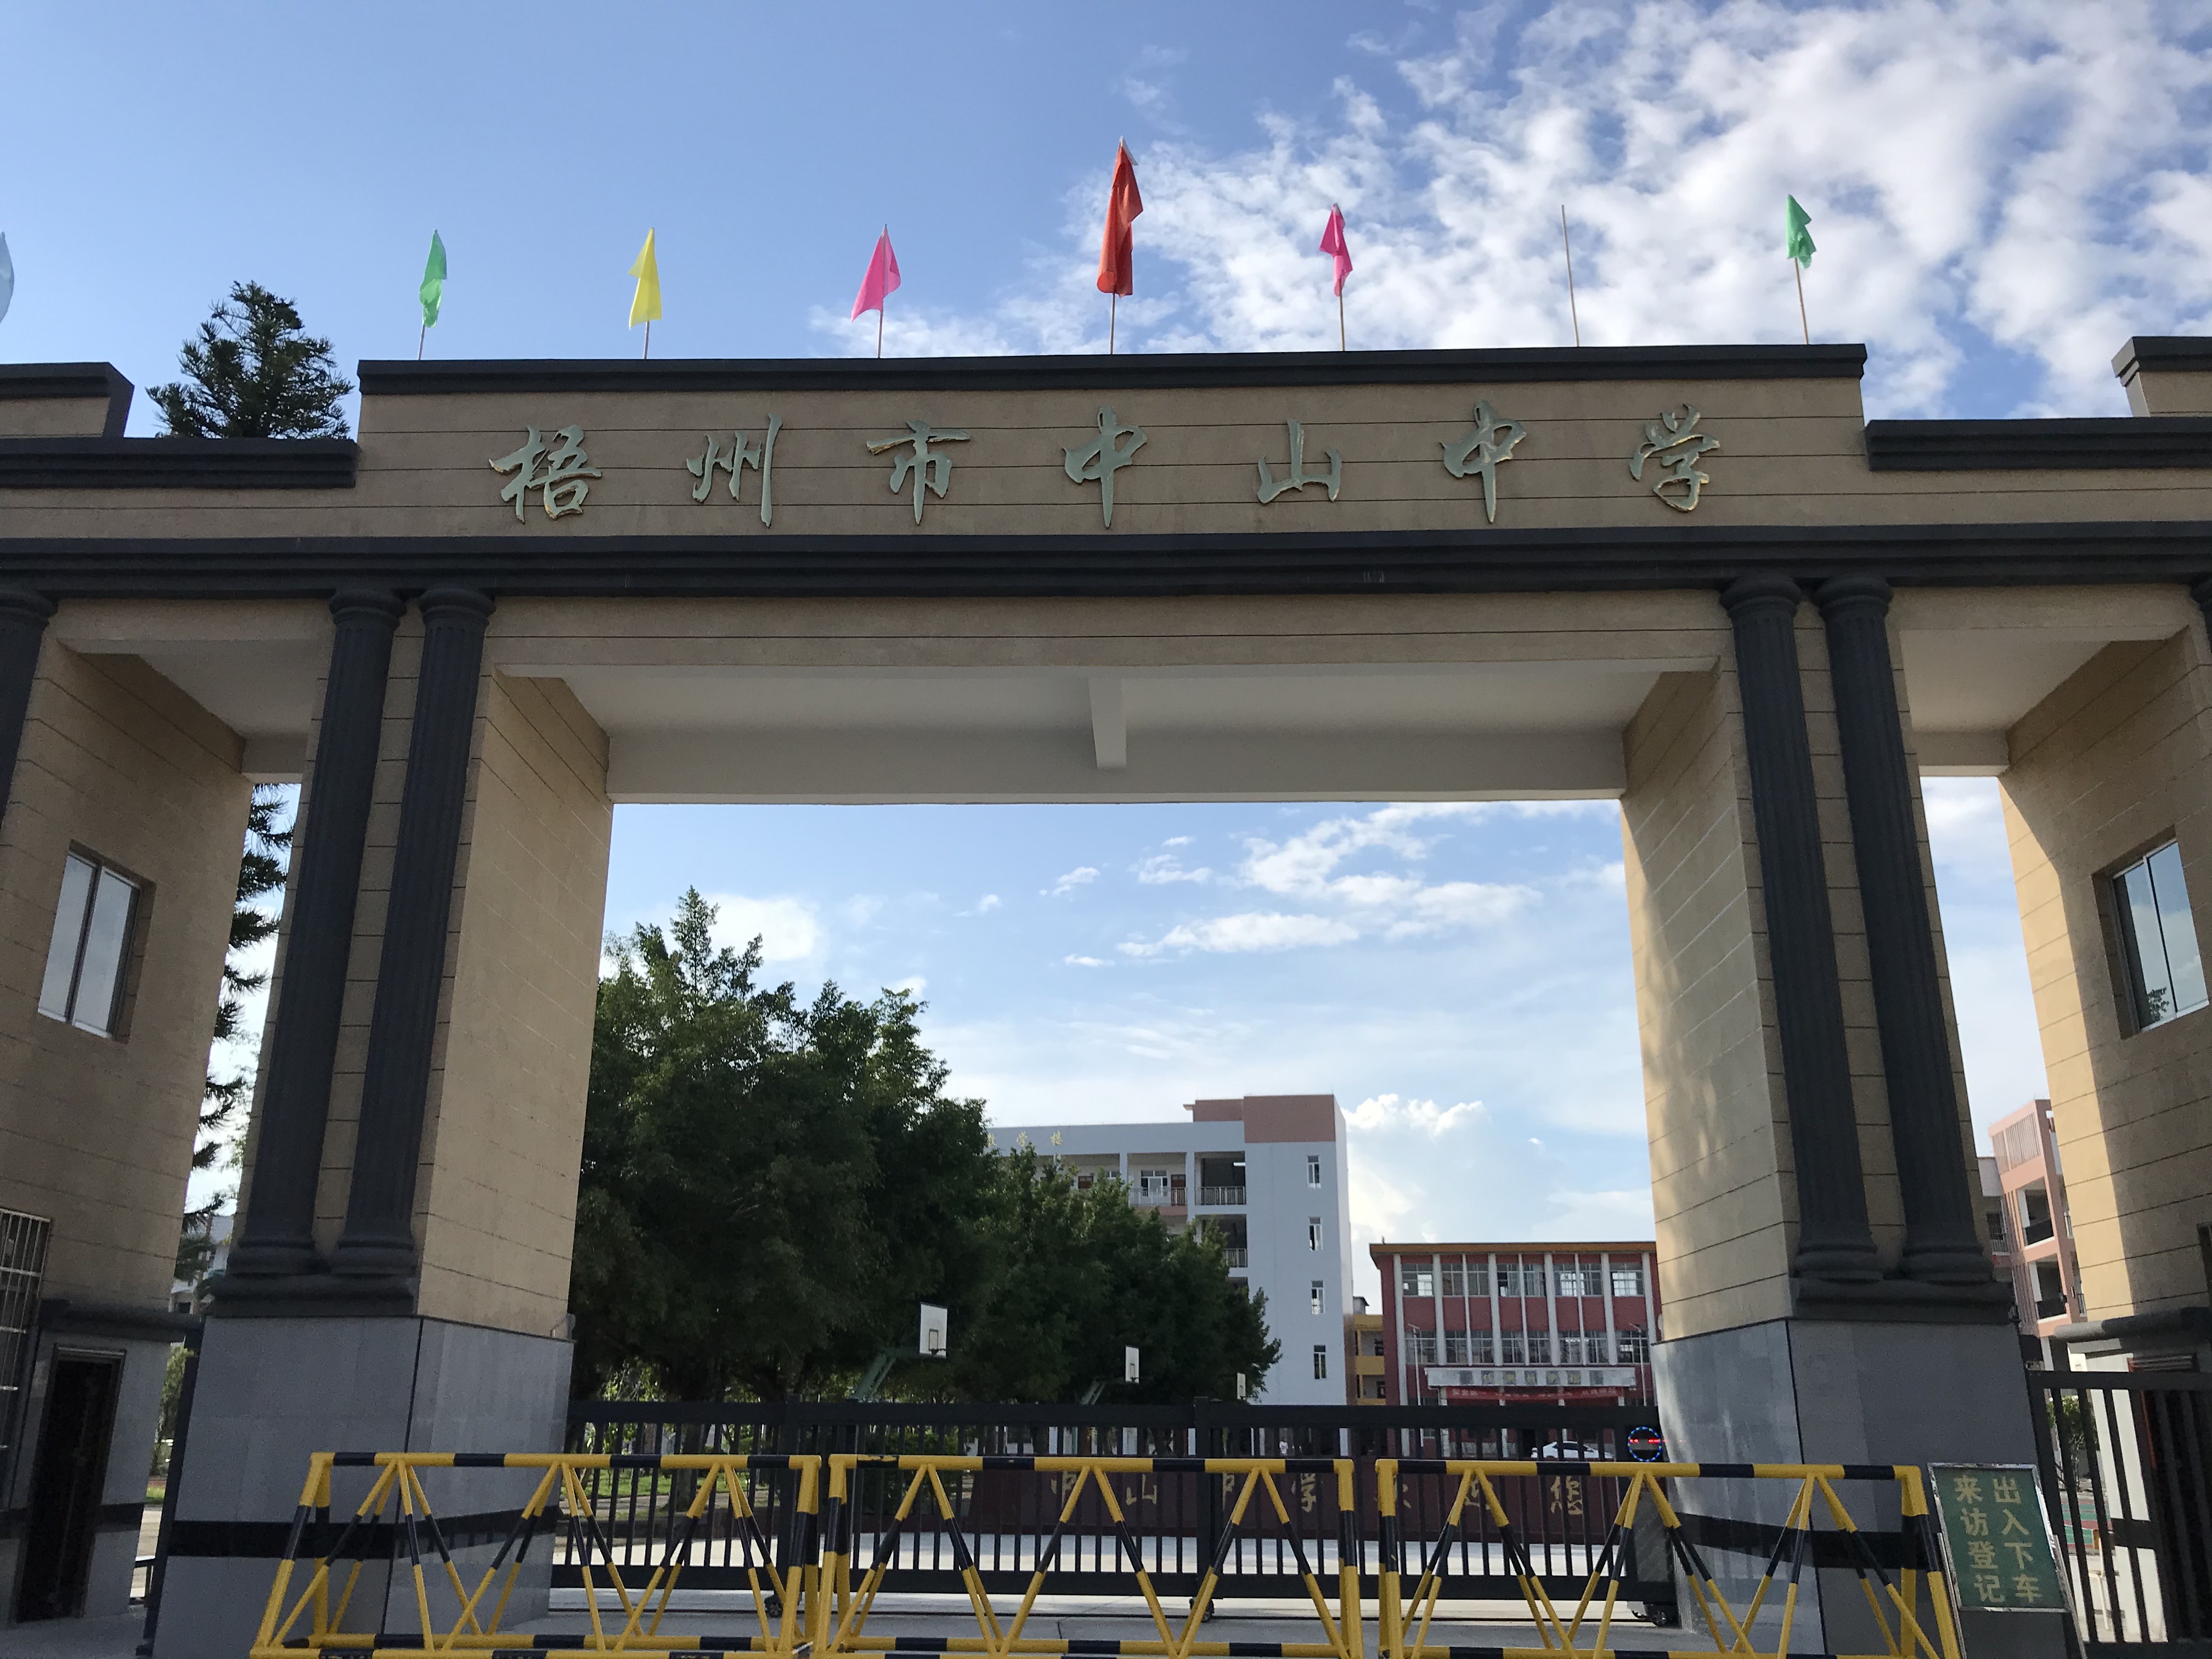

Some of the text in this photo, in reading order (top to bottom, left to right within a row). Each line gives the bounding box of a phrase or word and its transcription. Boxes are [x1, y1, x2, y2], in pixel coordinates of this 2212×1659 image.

[488, 399, 1721, 527] 梧州市中山中学
[1953, 1475, 2005, 1603] 来访登记
[1992, 1475, 2043, 1604] 出入下车
